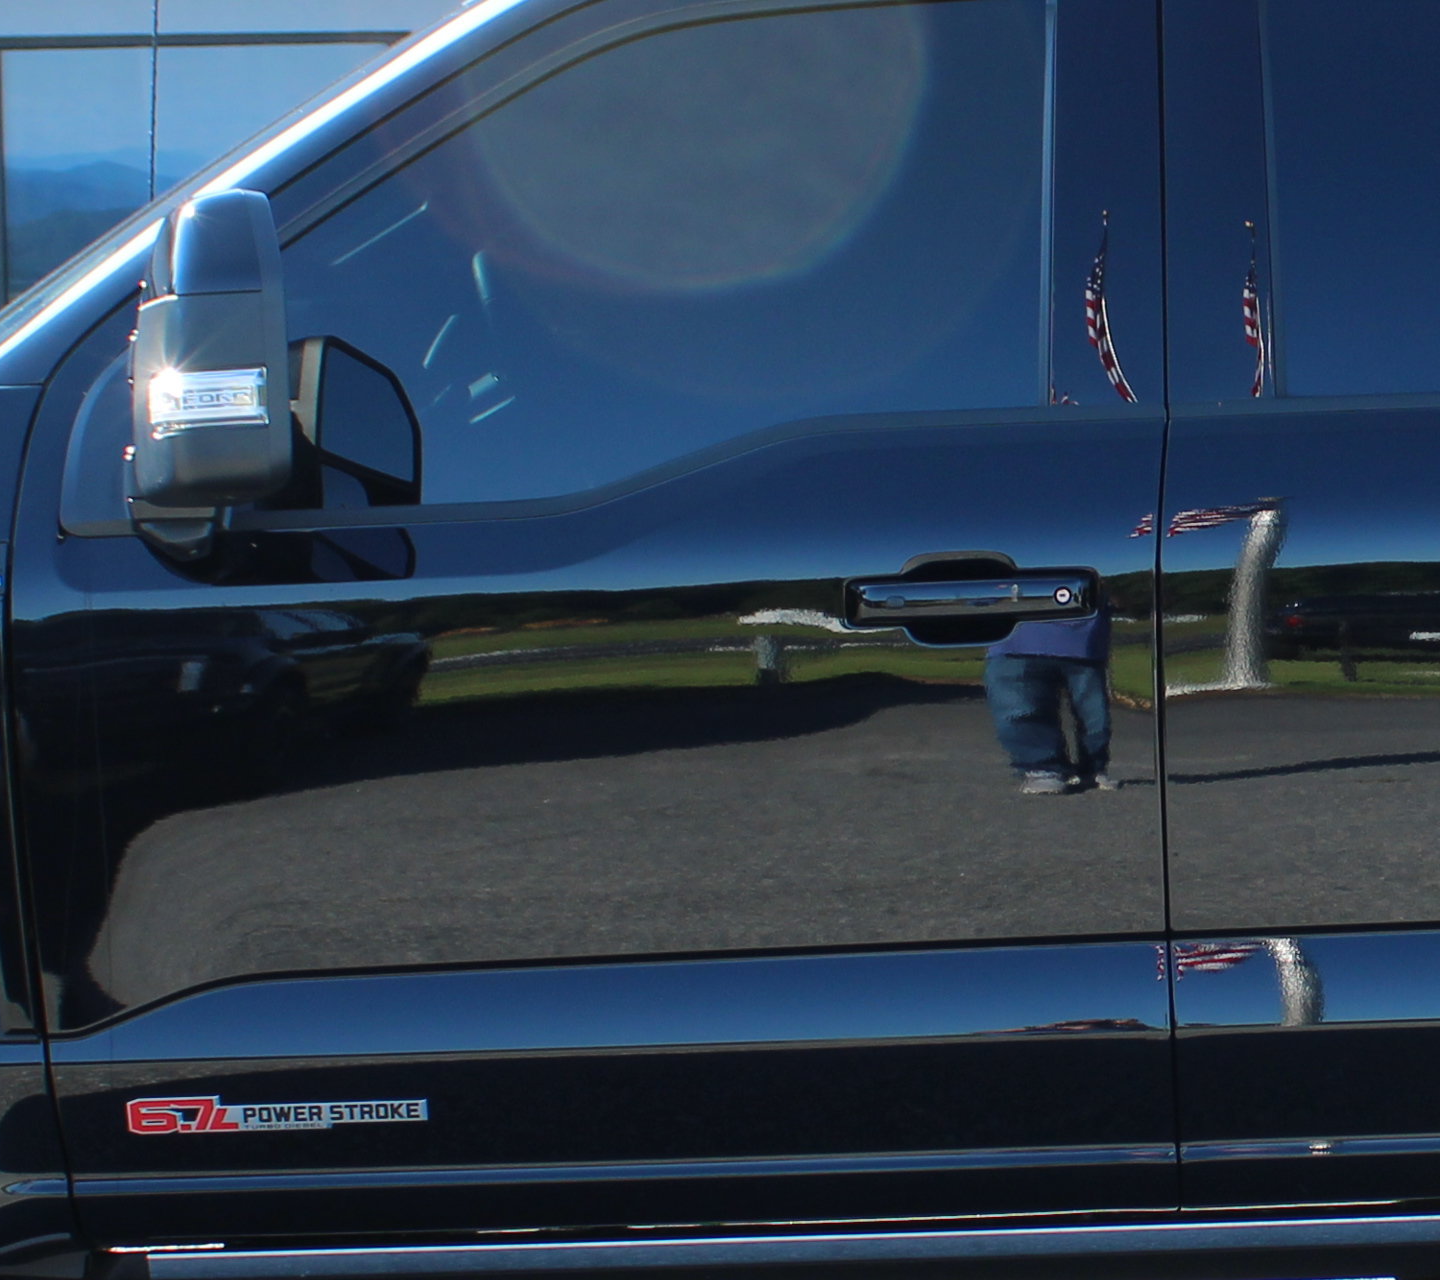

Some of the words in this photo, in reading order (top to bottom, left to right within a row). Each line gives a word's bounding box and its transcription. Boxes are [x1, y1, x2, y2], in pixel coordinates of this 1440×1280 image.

[126, 1096, 240, 1135] 6.7L
[243, 1105, 324, 1125] POWER
[330, 1101, 422, 1122] STROKE
